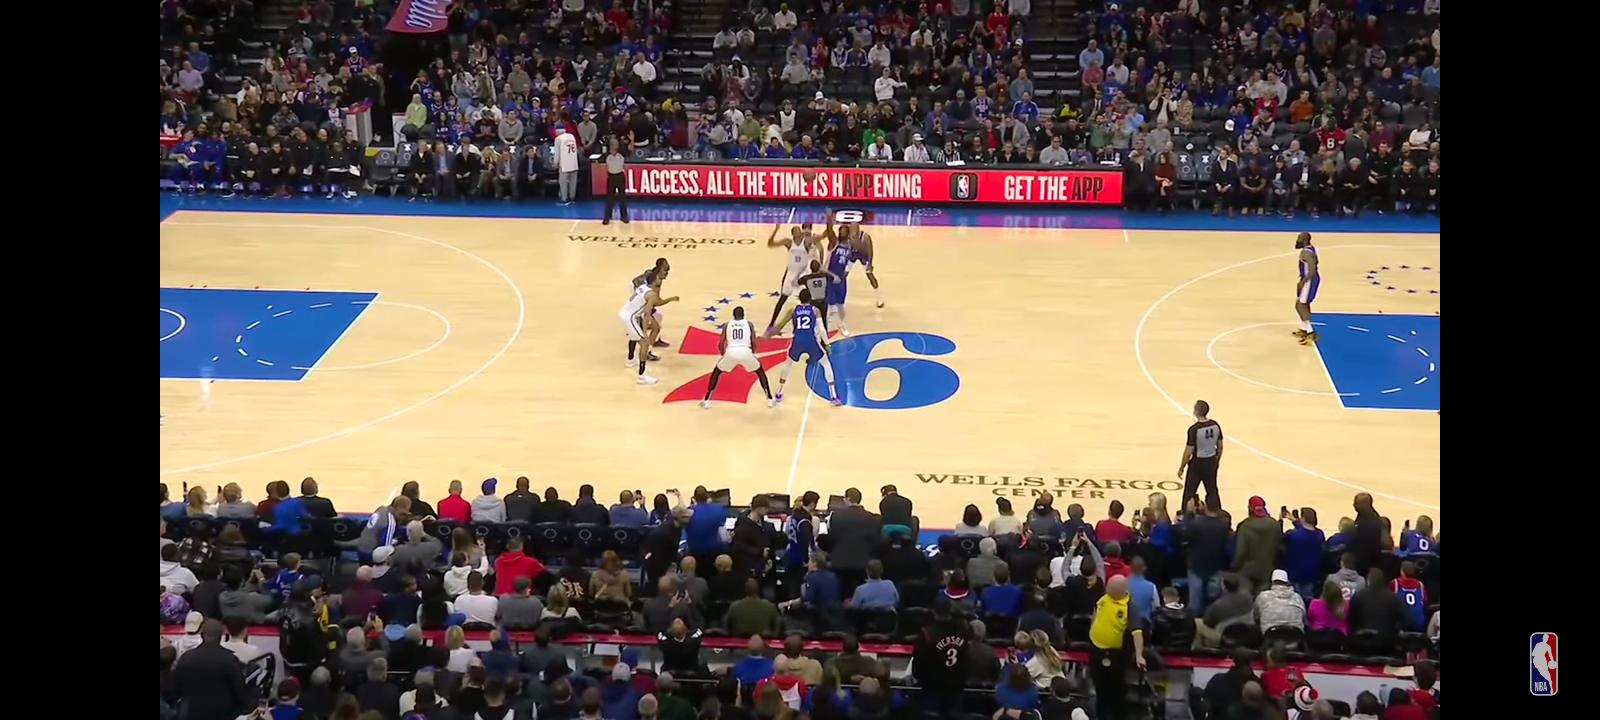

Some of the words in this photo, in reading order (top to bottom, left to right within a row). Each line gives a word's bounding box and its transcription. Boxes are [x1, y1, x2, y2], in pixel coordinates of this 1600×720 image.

[640, 168, 704, 197] ACCESS,
[706, 170, 734, 196] ALL
[737, 170, 766, 197] THE
[770, 171, 809, 197] TIME
[813, 172, 829, 198] IS
[832, 172, 922, 199] HAPPENING
[1004, 175, 1037, 201] GET
[1038, 175, 1068, 201] THE
[1071, 176, 1105, 201] APP
[567, 235, 660, 243] WELLS
[667, 237, 757, 246] FARGO
[796, 316, 811, 330] 12
[732, 328, 744, 341] 00
[915, 473, 1046, 487] WELLS
[1055, 477, 1184, 491] FARGO
[991, 488, 1106, 499] CENTER
[1419, 538, 1429, 550] 0
[1406, 593, 1415, 605] 0
[945, 648, 957, 667] 3
